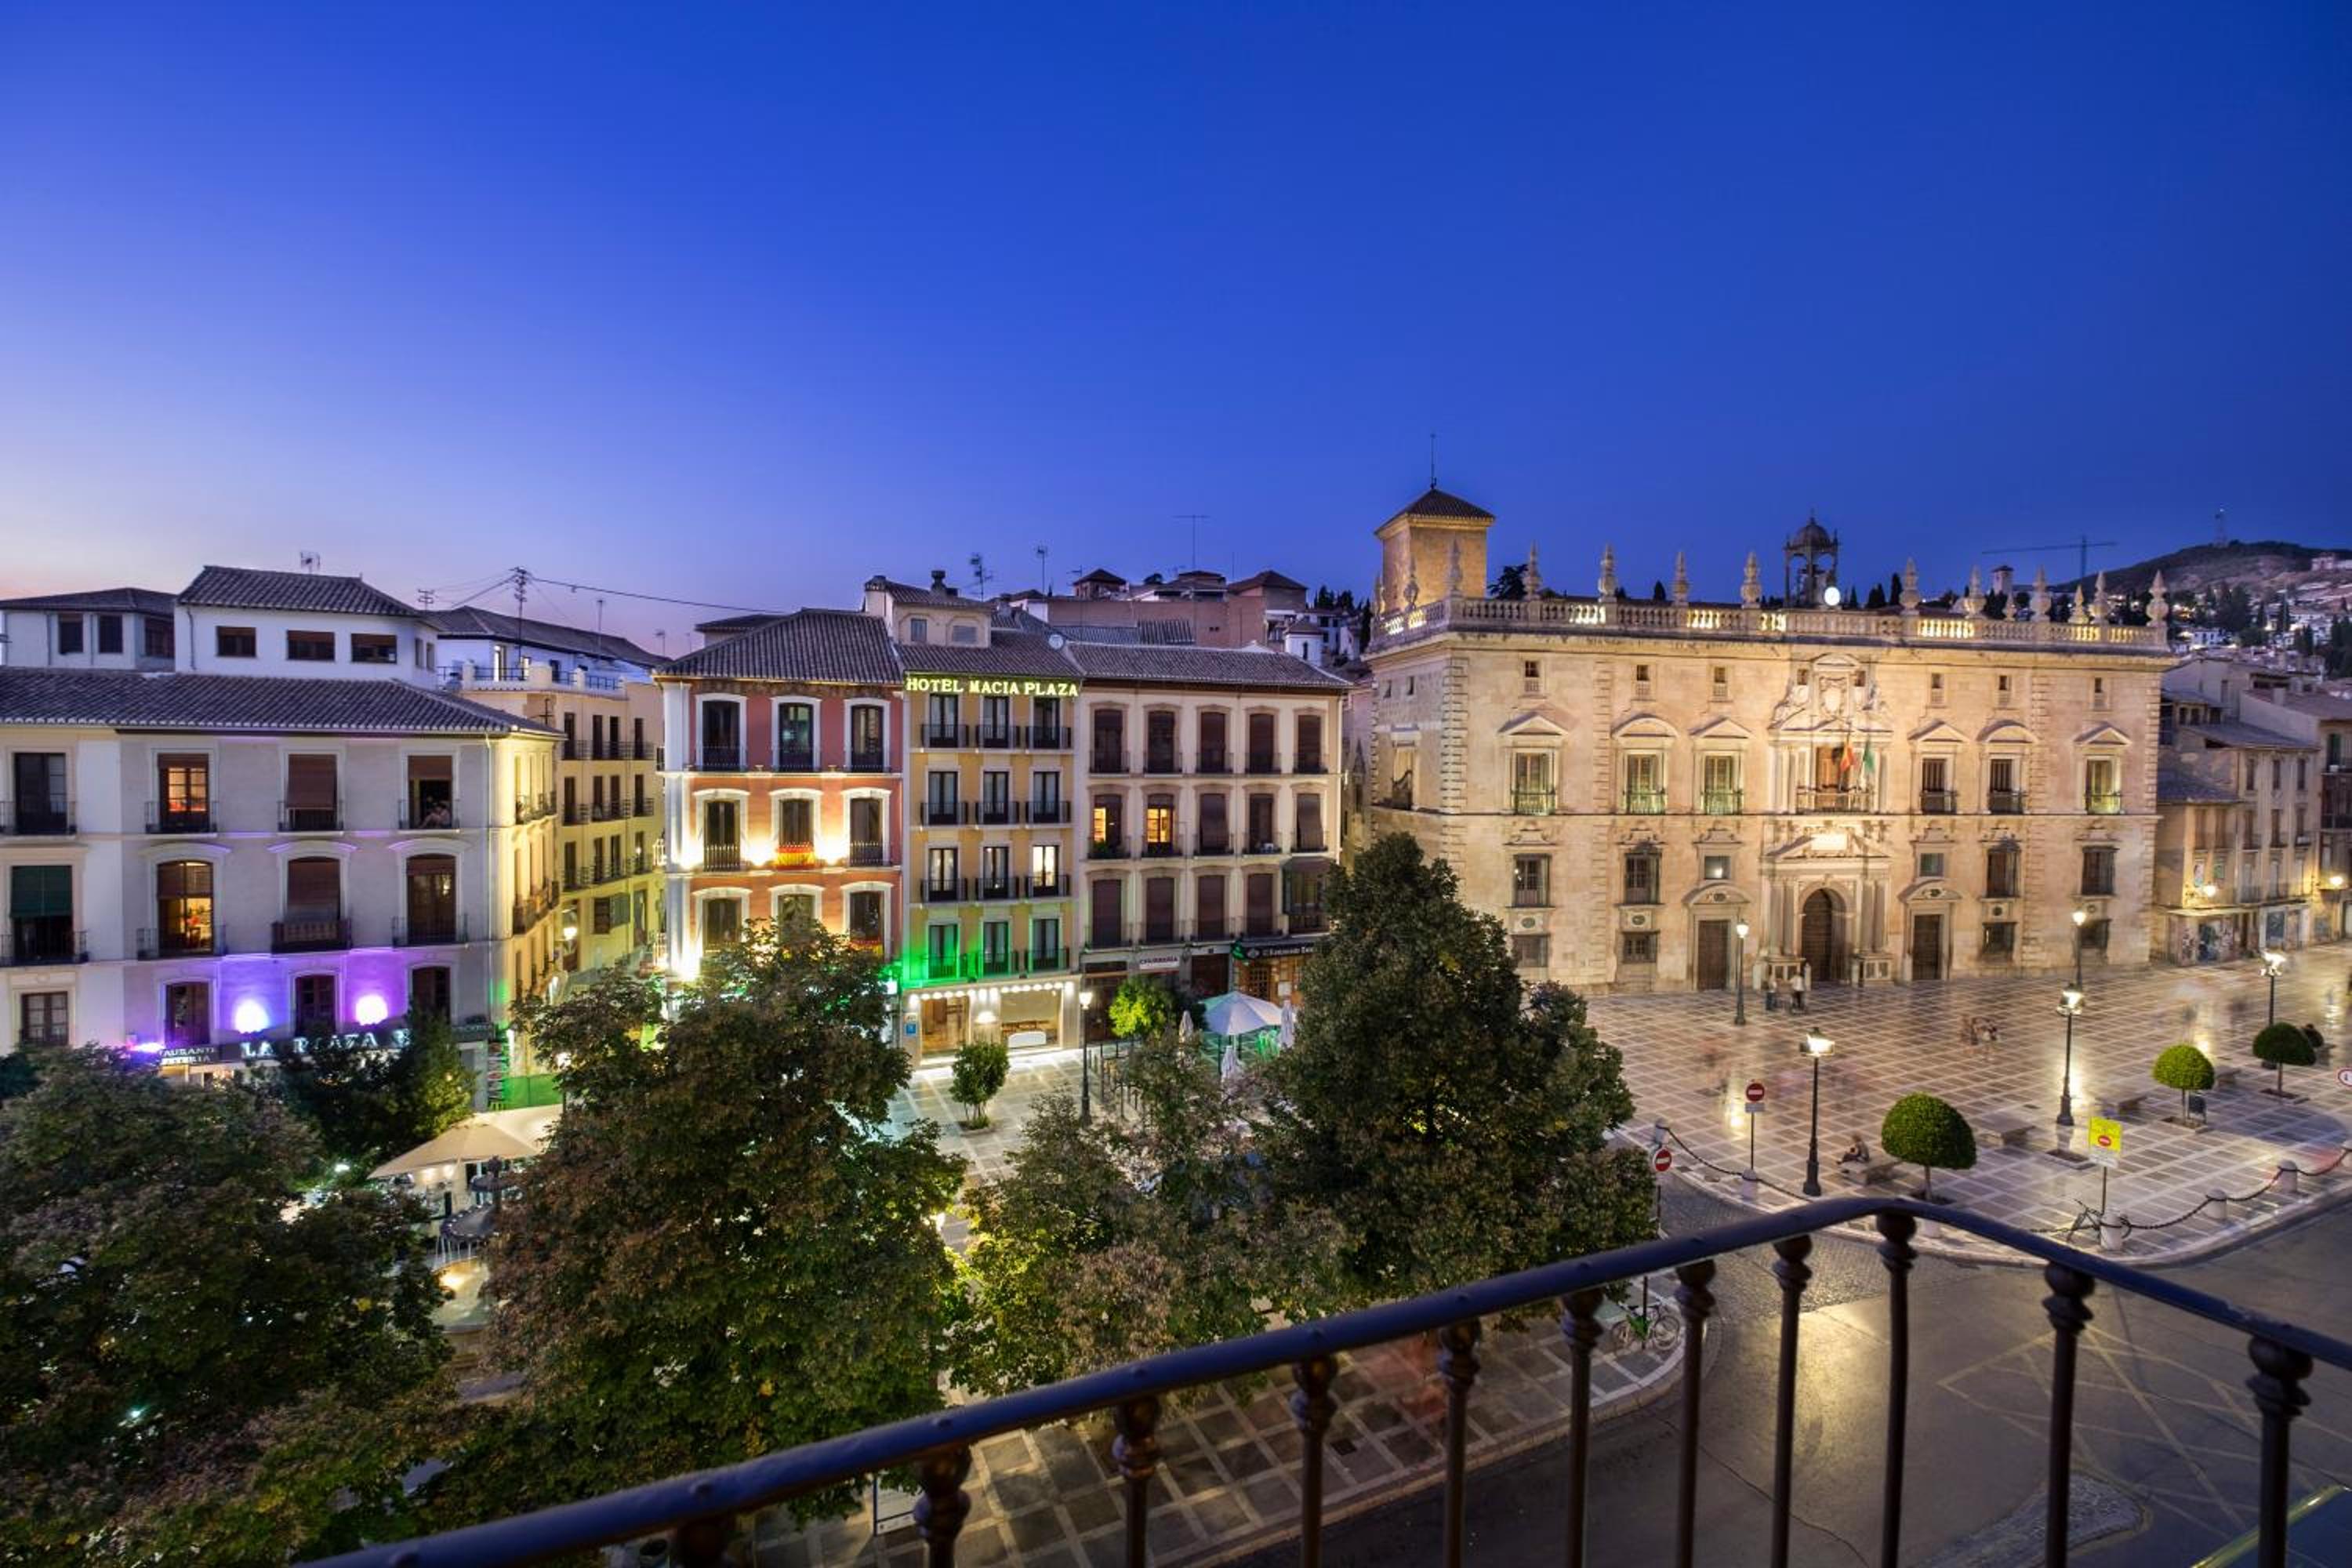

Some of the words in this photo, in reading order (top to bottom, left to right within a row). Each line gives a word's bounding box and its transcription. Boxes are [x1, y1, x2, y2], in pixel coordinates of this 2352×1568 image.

[906, 678, 964, 692] HOTEL
[969, 681, 1019, 695] MACIA
[1025, 682, 1078, 696] PLAZA
